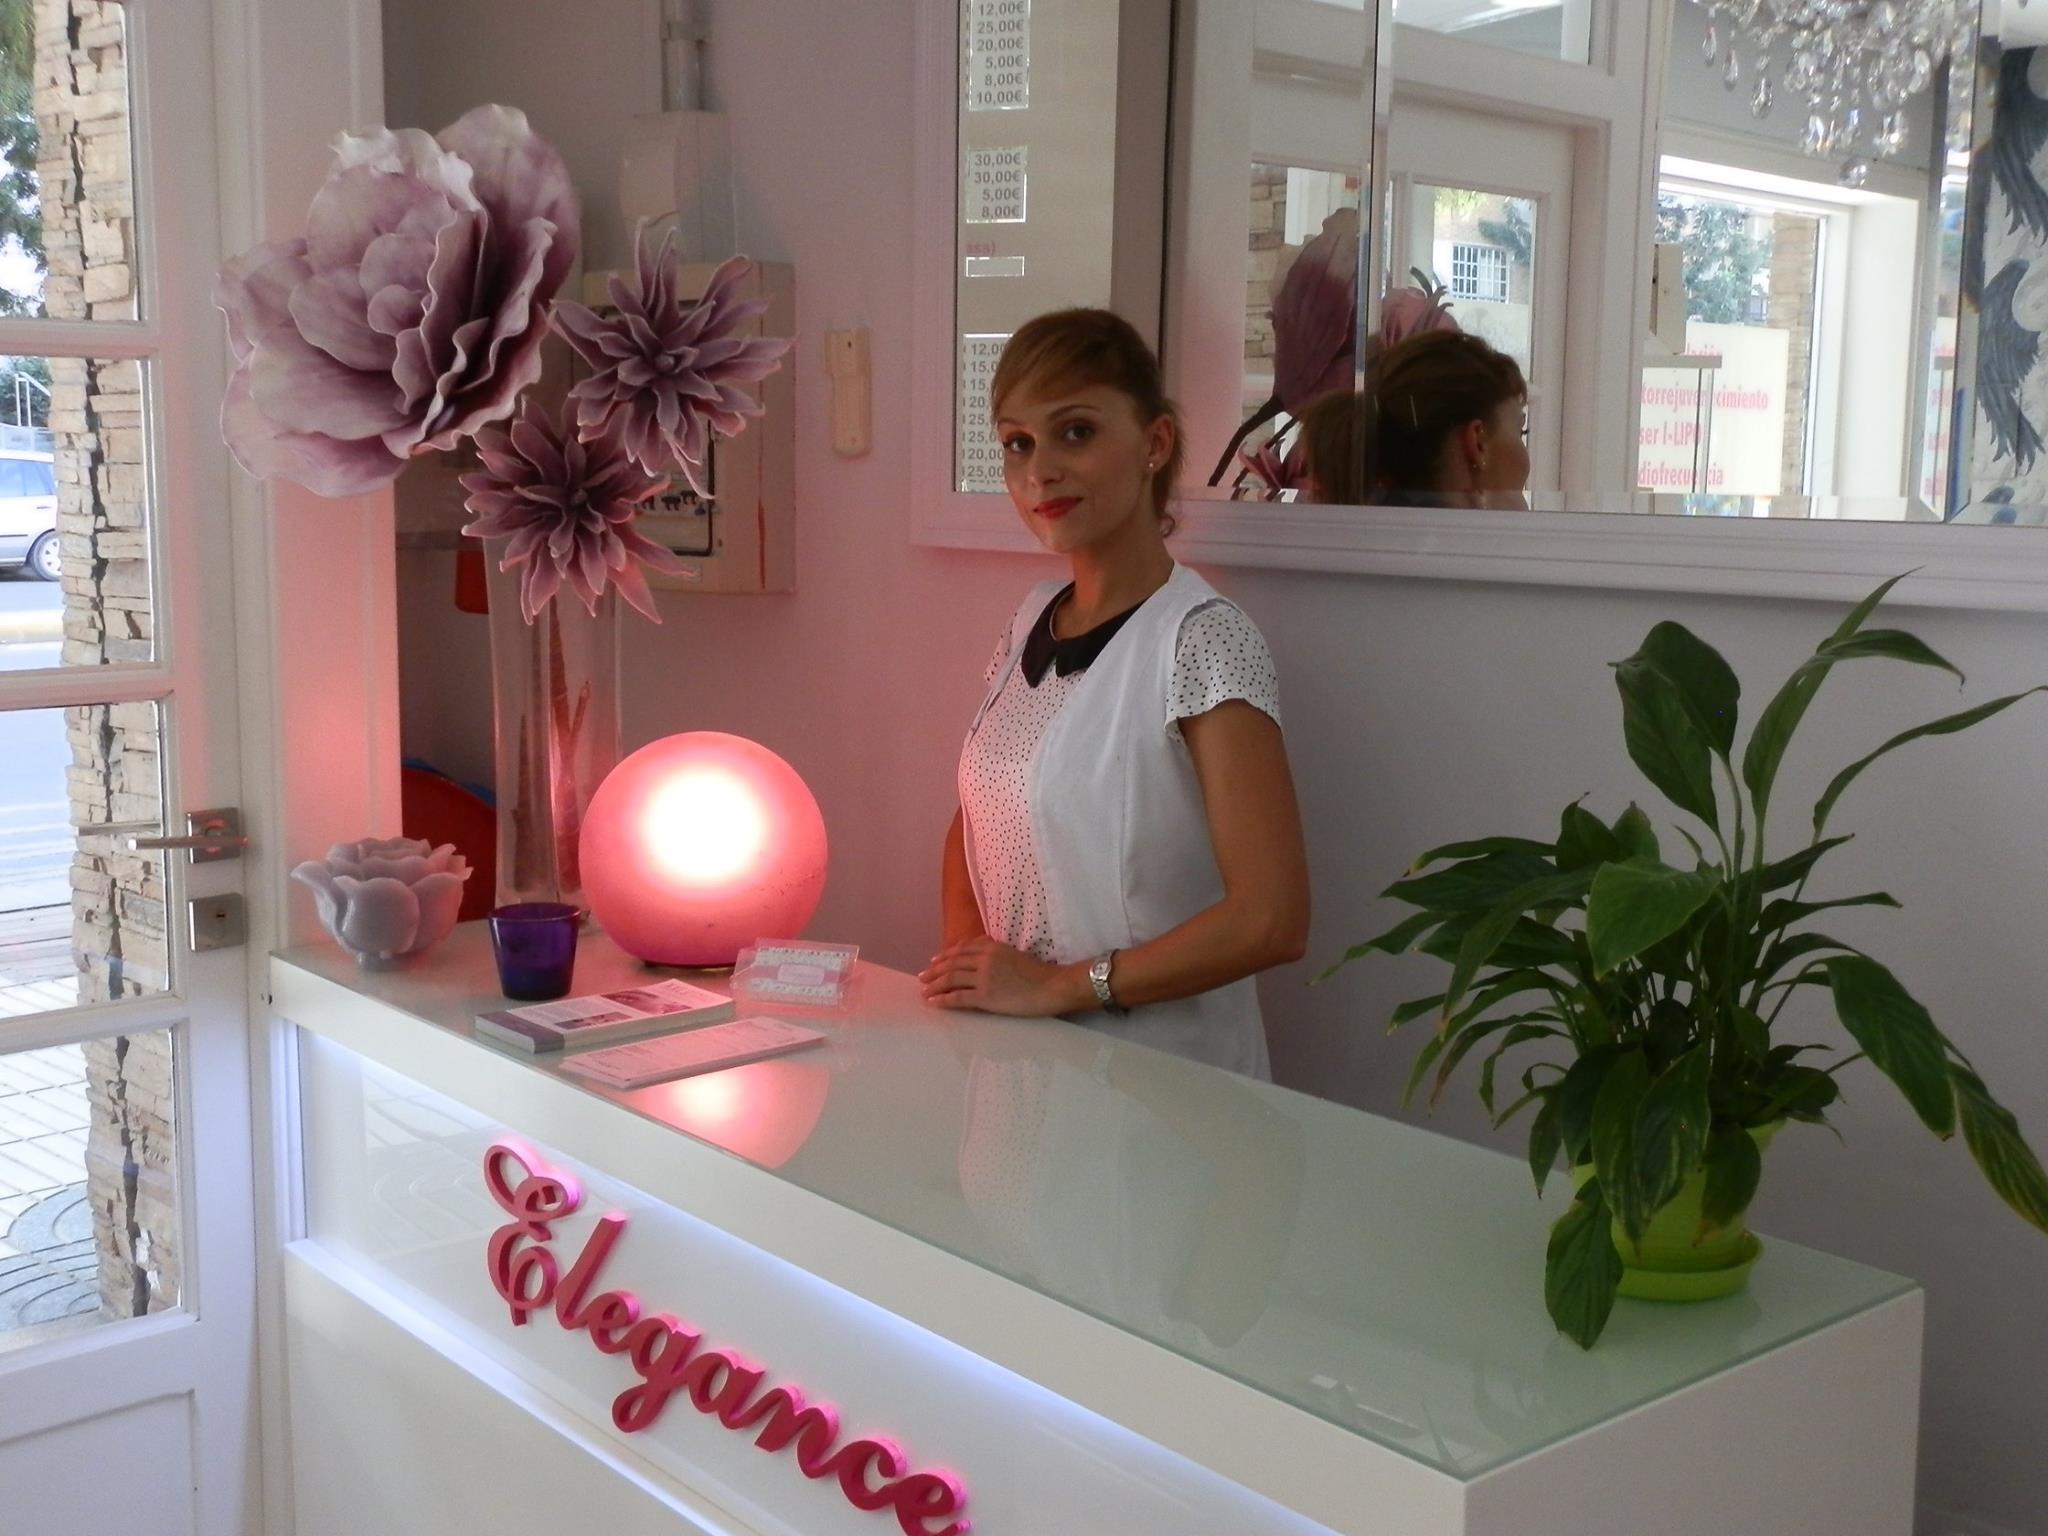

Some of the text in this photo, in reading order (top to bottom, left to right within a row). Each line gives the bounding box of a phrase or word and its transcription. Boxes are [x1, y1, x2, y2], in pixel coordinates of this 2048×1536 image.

[980, 1, 1025, 17] 12,00€
[977, 19, 1025, 34] 25,00€
[976, 37, 1024, 53] 20,00€
[985, 54, 1024, 70] 5,00€
[984, 72, 1023, 87] 8,00€
[977, 89, 1023, 105] 10,00€
[974, 152, 1021, 168] 30,00€
[974, 169, 1021, 185] 30,00€
[982, 187, 1020, 202] 5,00€
[981, 205, 1020, 219] 8,00€
[484, 1143, 969, 1536] Elegance
